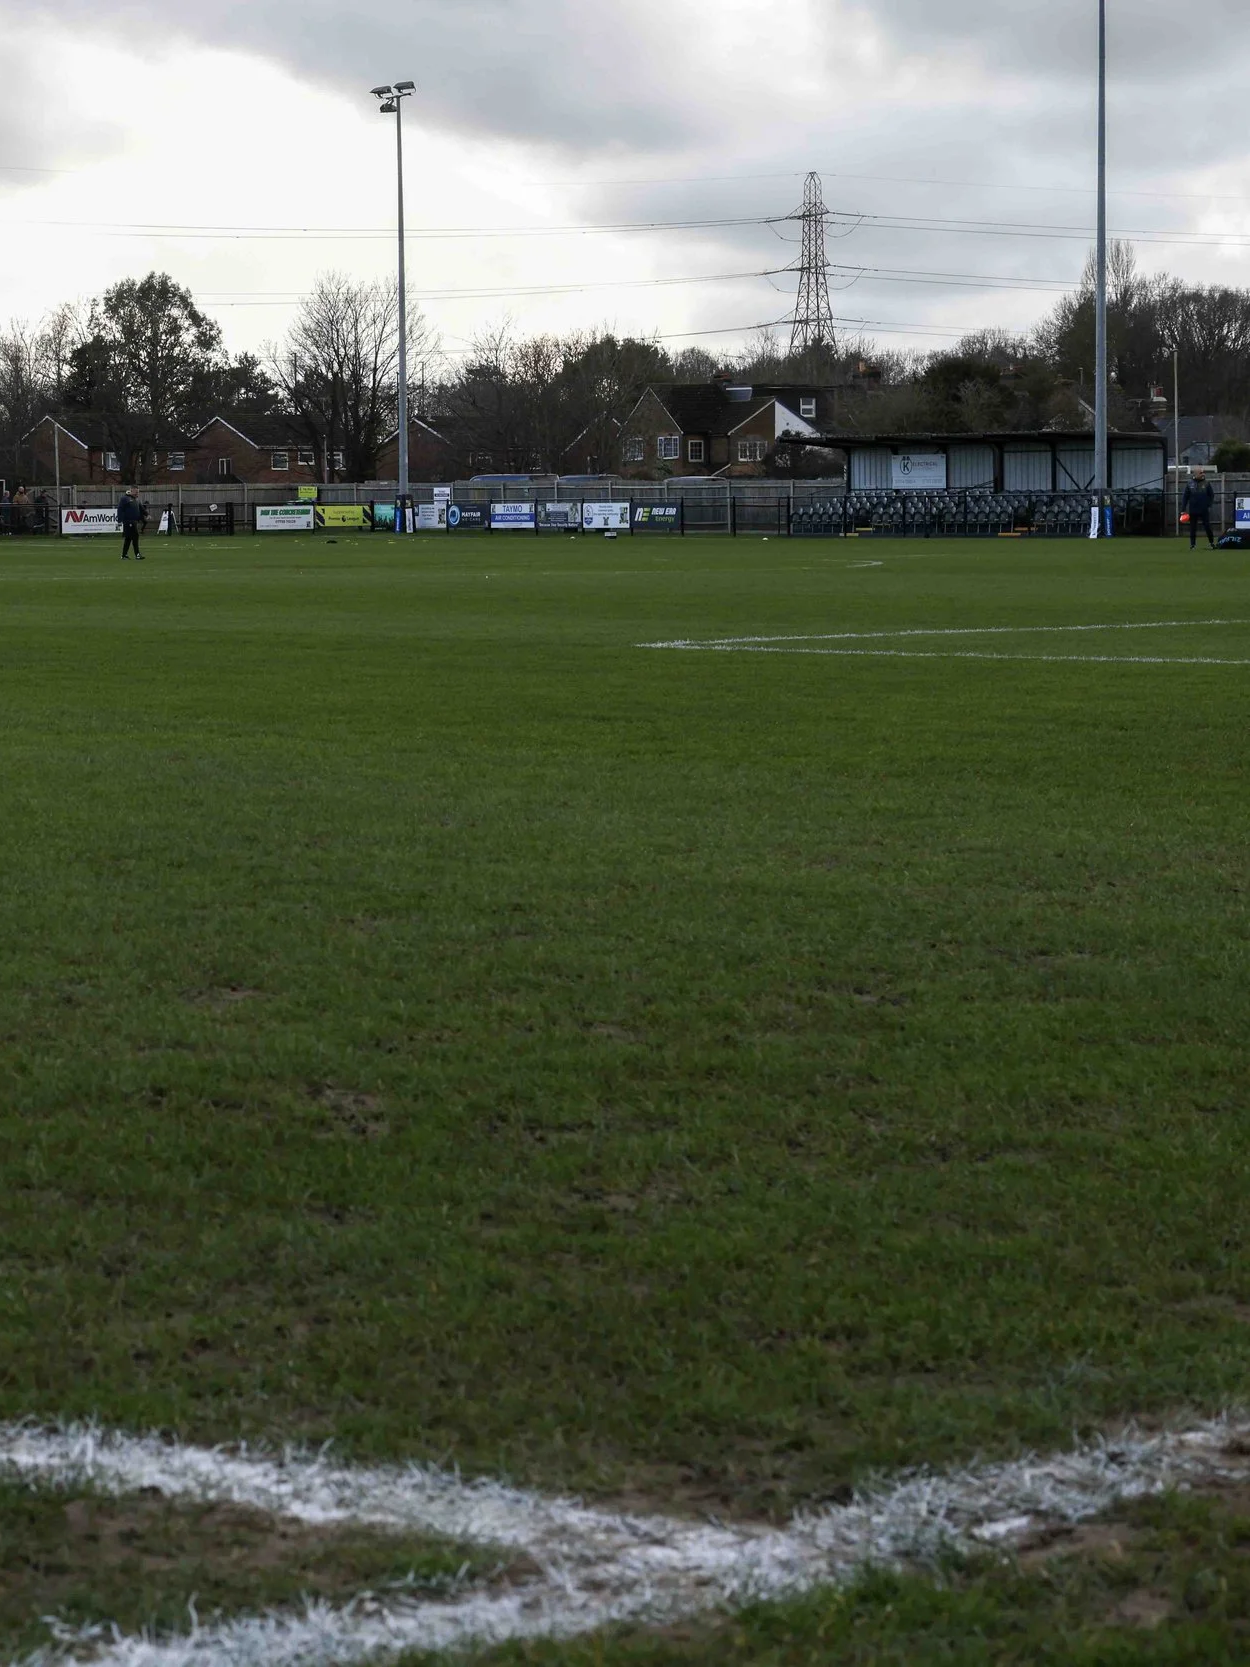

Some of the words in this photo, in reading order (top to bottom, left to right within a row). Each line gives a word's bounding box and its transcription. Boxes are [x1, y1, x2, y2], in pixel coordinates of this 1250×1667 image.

[503, 504, 523, 513] TAYMO
[651, 507, 665, 515] NEW
[665, 507, 677, 515] ERA
[655, 516, 675, 524] Energy
